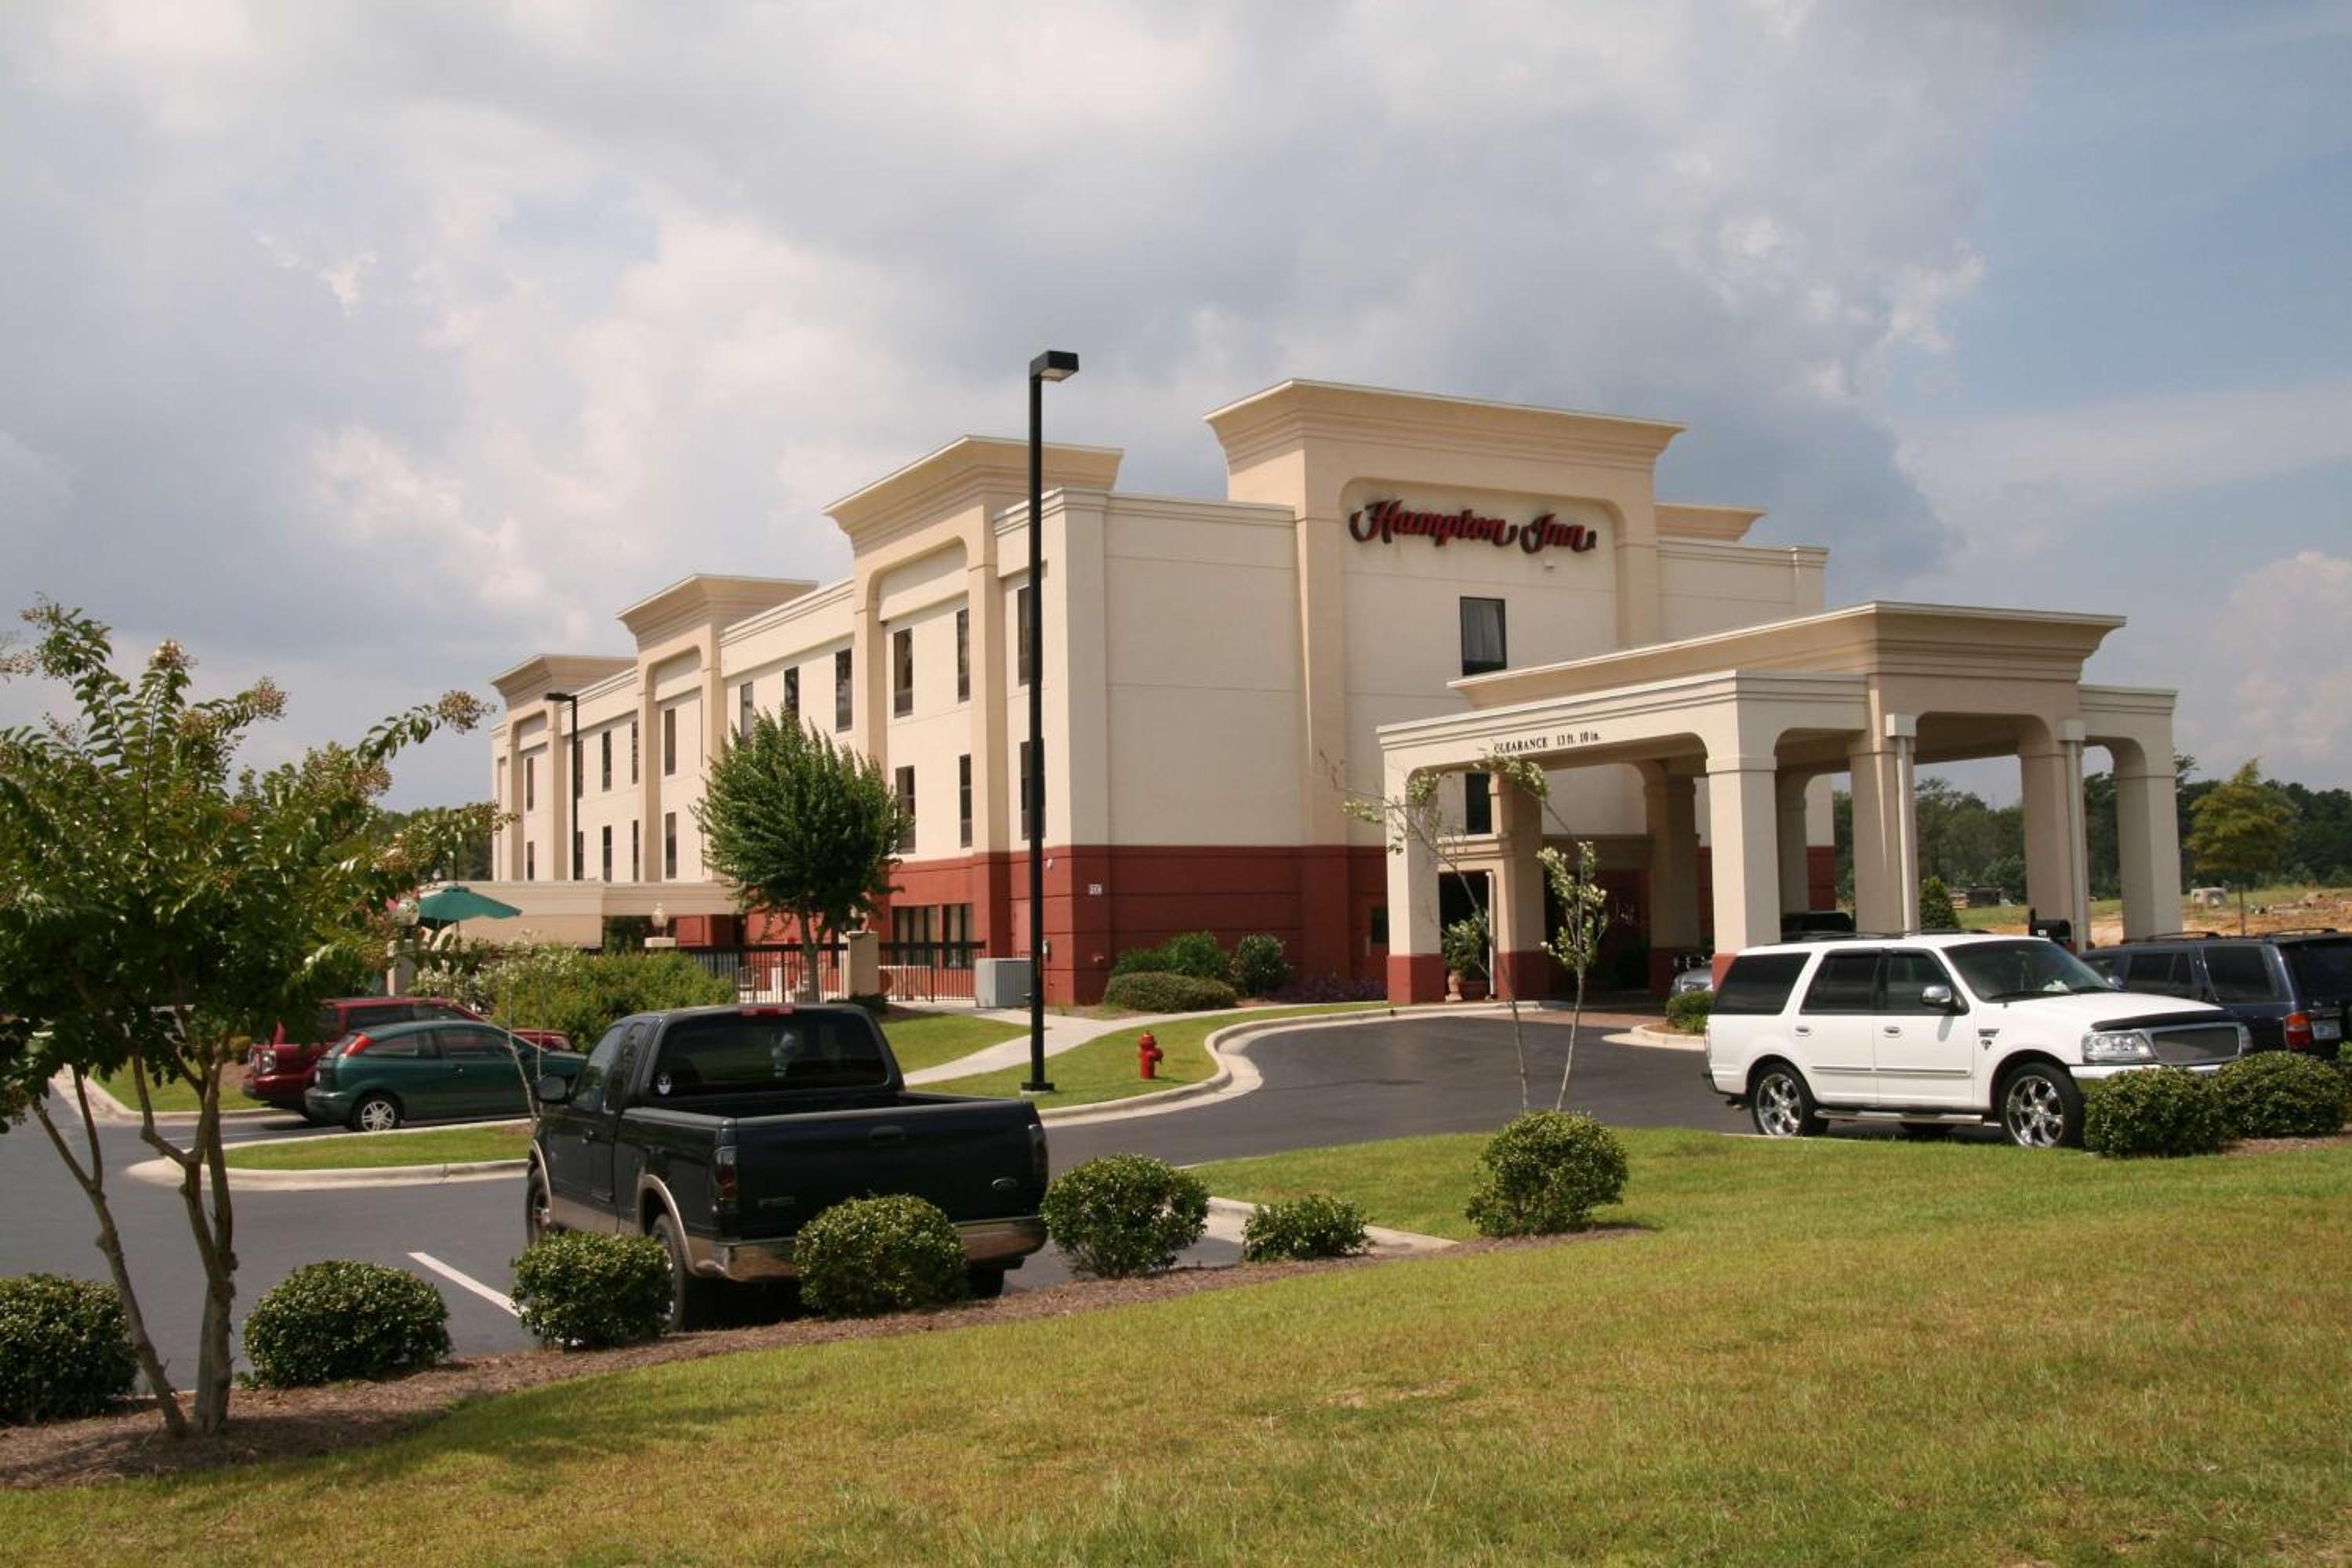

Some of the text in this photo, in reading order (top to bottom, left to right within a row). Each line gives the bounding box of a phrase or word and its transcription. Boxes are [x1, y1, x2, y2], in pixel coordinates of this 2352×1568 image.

[1349, 500, 1597, 554] Hampton Inn
[1494, 737, 1548, 753] CLEARANCE
